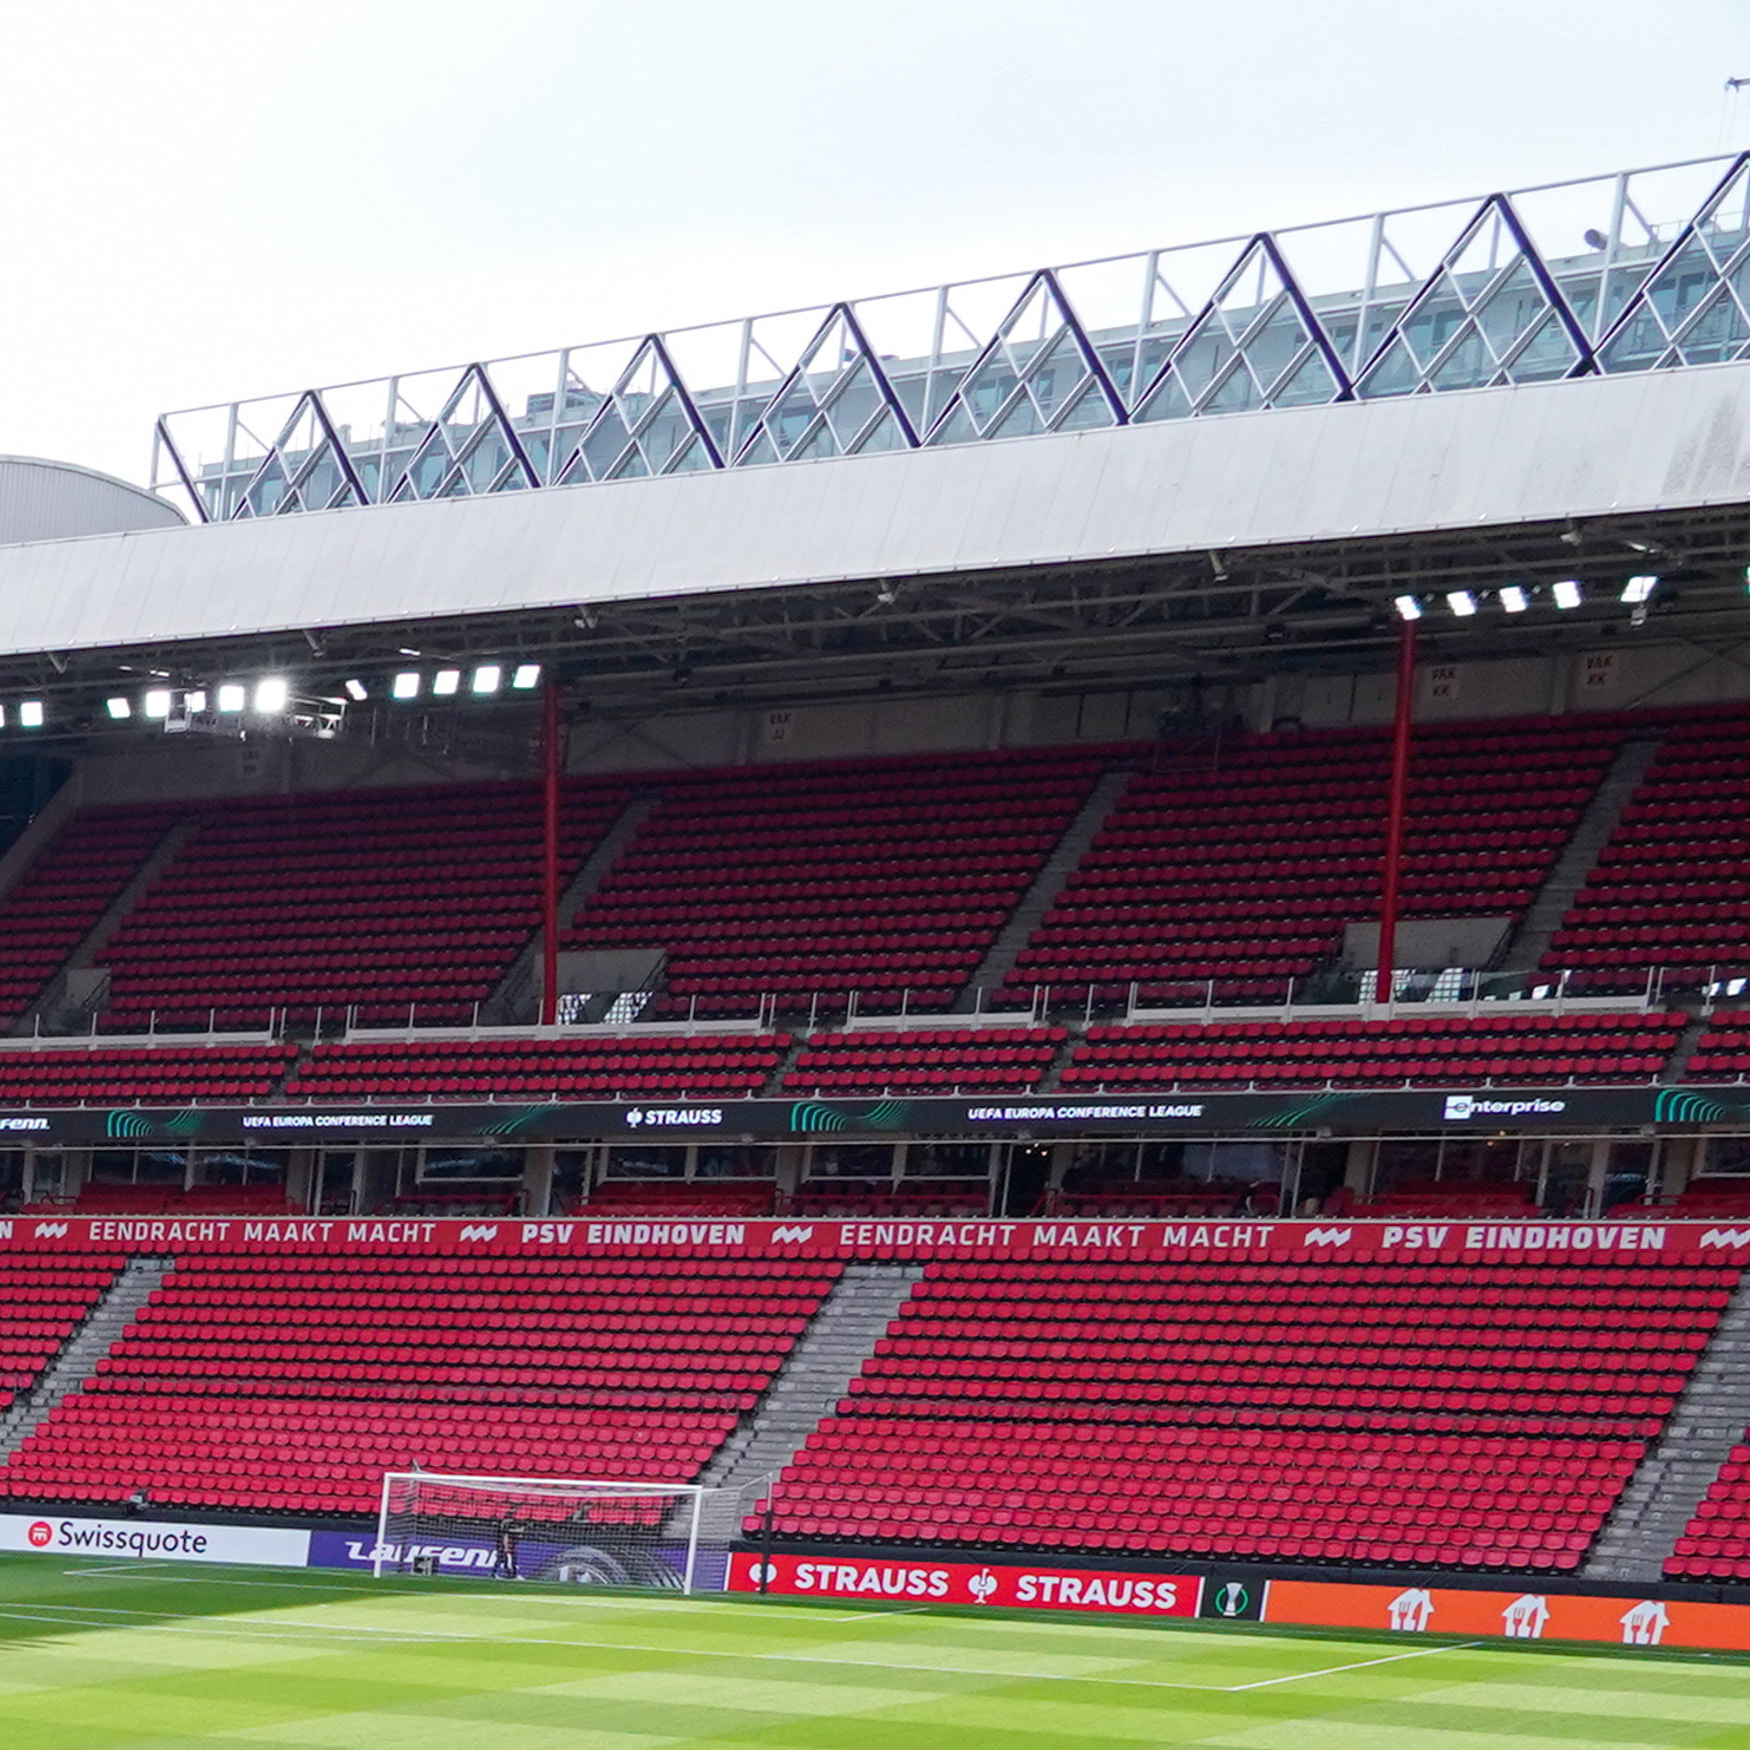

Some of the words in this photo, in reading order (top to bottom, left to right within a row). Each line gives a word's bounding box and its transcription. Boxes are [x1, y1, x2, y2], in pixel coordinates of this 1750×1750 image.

[644, 1108, 722, 1125] STRAUSS
[967, 1107, 1003, 1120] UEFA
[1004, 1107, 1055, 1119] EUROPA
[1056, 1105, 1147, 1119] CONFERENCE
[1148, 1104, 1204, 1118] LEAGUE
[1444, 1095, 1566, 1120] enterprise
[242, 1116, 272, 1128] UEFA
[272, 1115, 314, 1127] EUROPA
[314, 1114, 388, 1127] CONFERENCE
[389, 1114, 434, 1126] LEAGUE
[89, 1222, 231, 1241] EENDRACHT
[244, 1223, 334, 1242] MAAKT
[347, 1223, 436, 1243] MACHT
[521, 1224, 574, 1243] PSV
[587, 1224, 745, 1245] EINDHOVEN
[840, 1225, 1016, 1245] EENDRACHT
[1033, 1225, 1145, 1246] MAAKT
[1162, 1226, 1274, 1247] MACHT
[1382, 1226, 1448, 1248] PSV
[1465, 1226, 1666, 1249] EINDHOVEN
[58, 1521, 208, 1558] Swissquote
[794, 1564, 950, 1597] STRAUSS
[1015, 1574, 1178, 1610] STRAUSS
